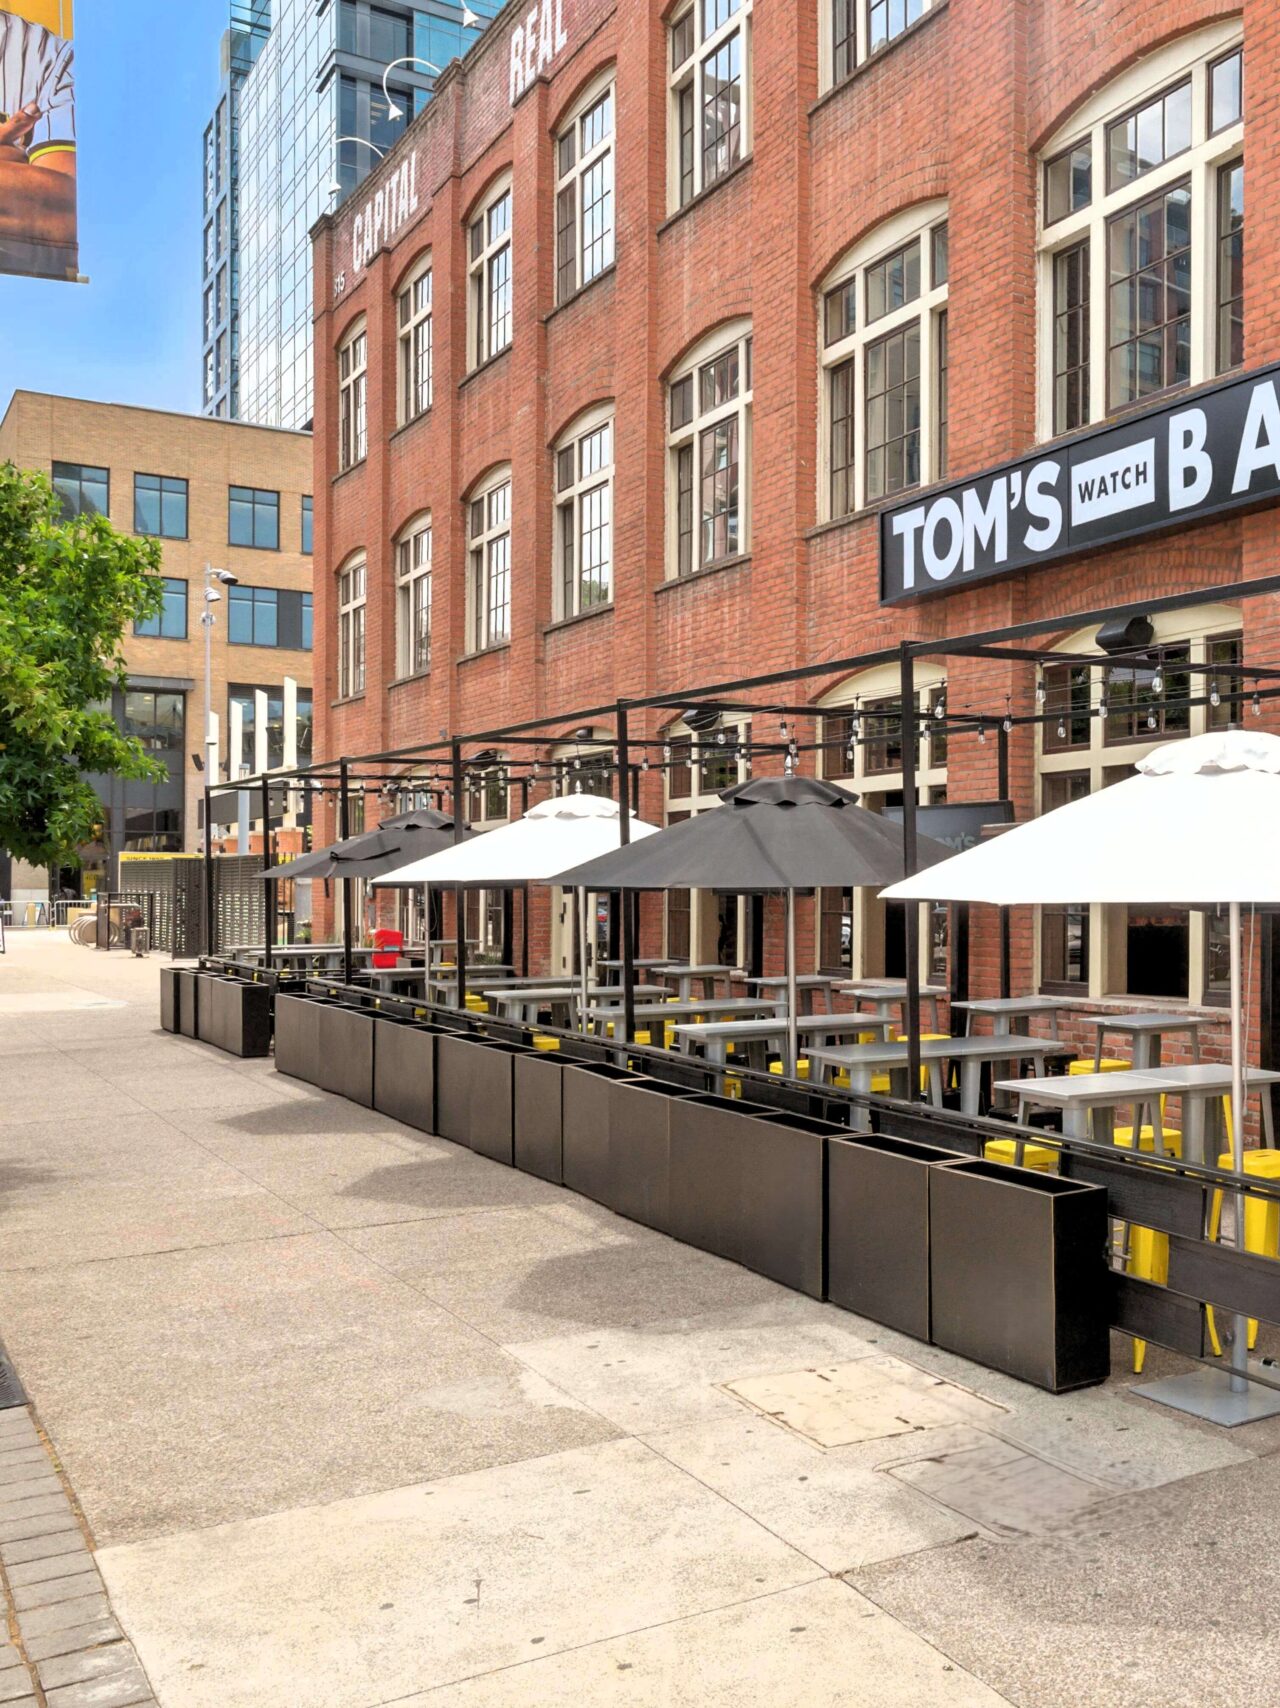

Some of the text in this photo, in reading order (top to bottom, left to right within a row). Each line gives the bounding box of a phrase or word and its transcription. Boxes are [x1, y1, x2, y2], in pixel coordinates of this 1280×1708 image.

[509, 0, 568, 106] REAL
[352, 150, 418, 273] CAPITAL
[892, 459, 1063, 590] TOM'S
[1078, 461, 1148, 505] WATCH
